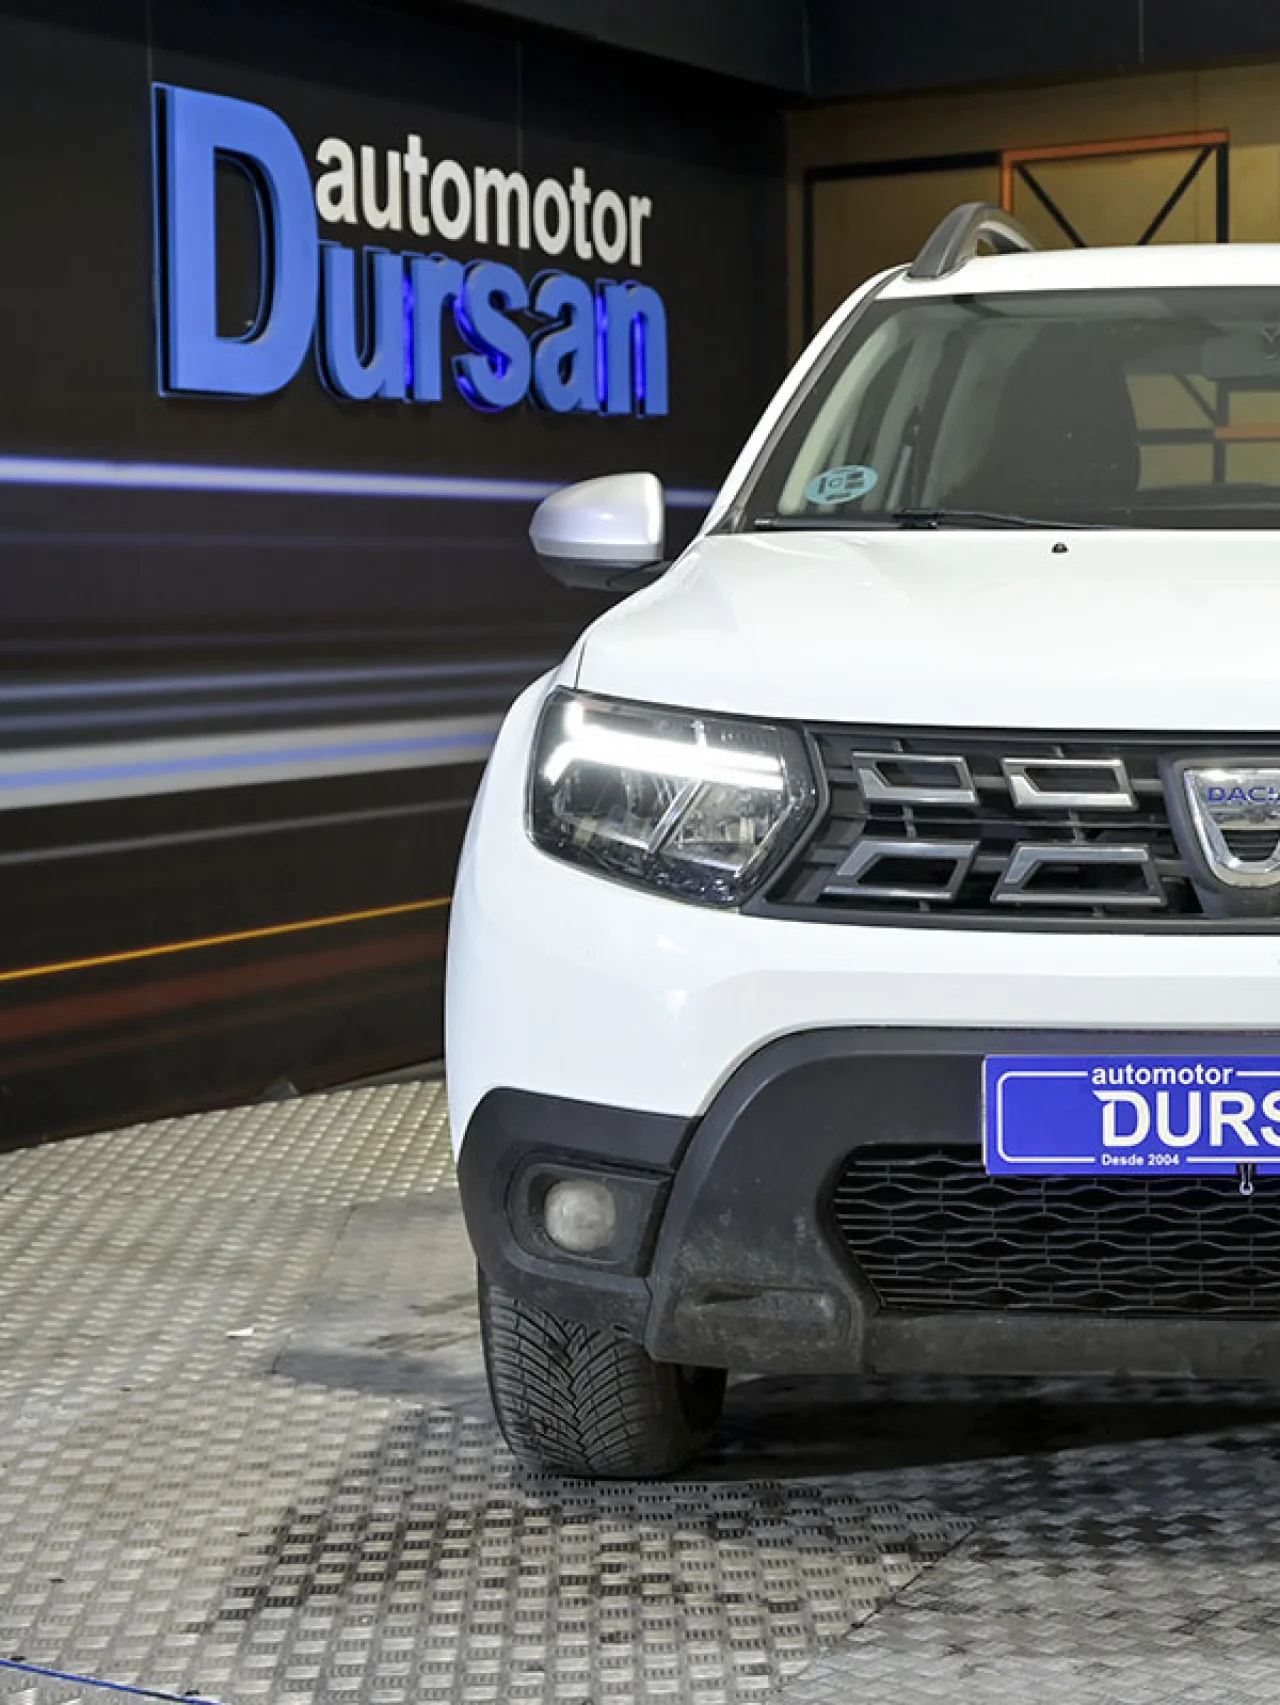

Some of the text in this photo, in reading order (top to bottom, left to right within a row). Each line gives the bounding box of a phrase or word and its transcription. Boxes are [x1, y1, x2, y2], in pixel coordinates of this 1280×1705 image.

[315, 133, 652, 267] automotor
[152, 81, 669, 416] Dursan
[1091, 1063, 1234, 1085] automotor
[1102, 1154, 1180, 1166] Desde 2004
